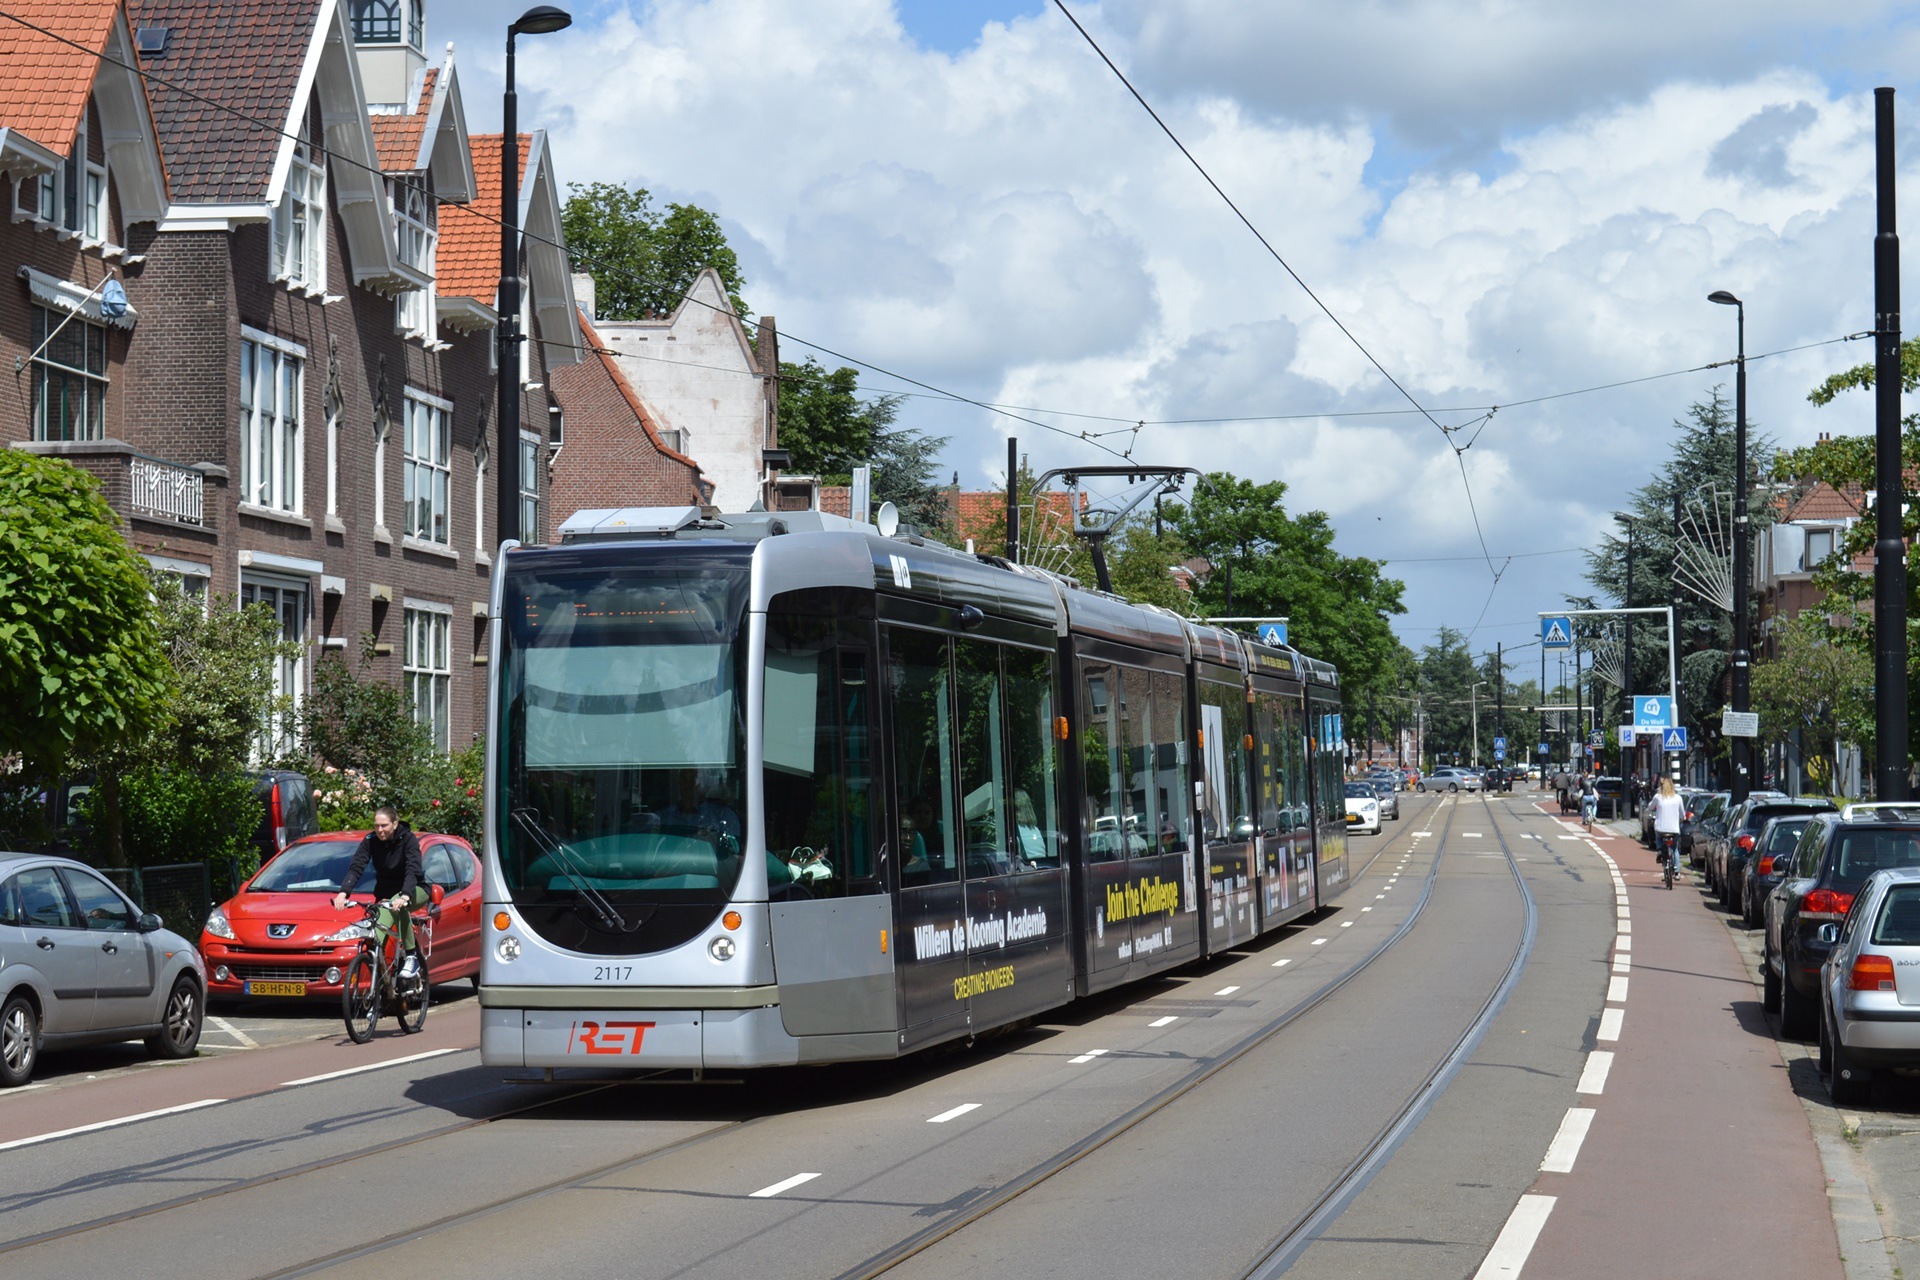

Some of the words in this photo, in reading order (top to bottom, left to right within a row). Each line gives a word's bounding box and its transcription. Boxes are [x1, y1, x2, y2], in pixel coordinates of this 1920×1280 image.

[1107, 883, 1124, 922] Join
[1125, 881, 1140, 918] the
[1140, 875, 1178, 917] Challenge
[914, 924, 951, 960] Willem
[952, 920, 965, 952] de
[967, 913, 1005, 949] Kooning
[1007, 905, 1047, 941] Academie
[594, 966, 633, 981] 2117
[954, 972, 985, 1000] CREATING
[985, 965, 1015, 992] PIONEERS
[579, 1021, 657, 1054] RET
